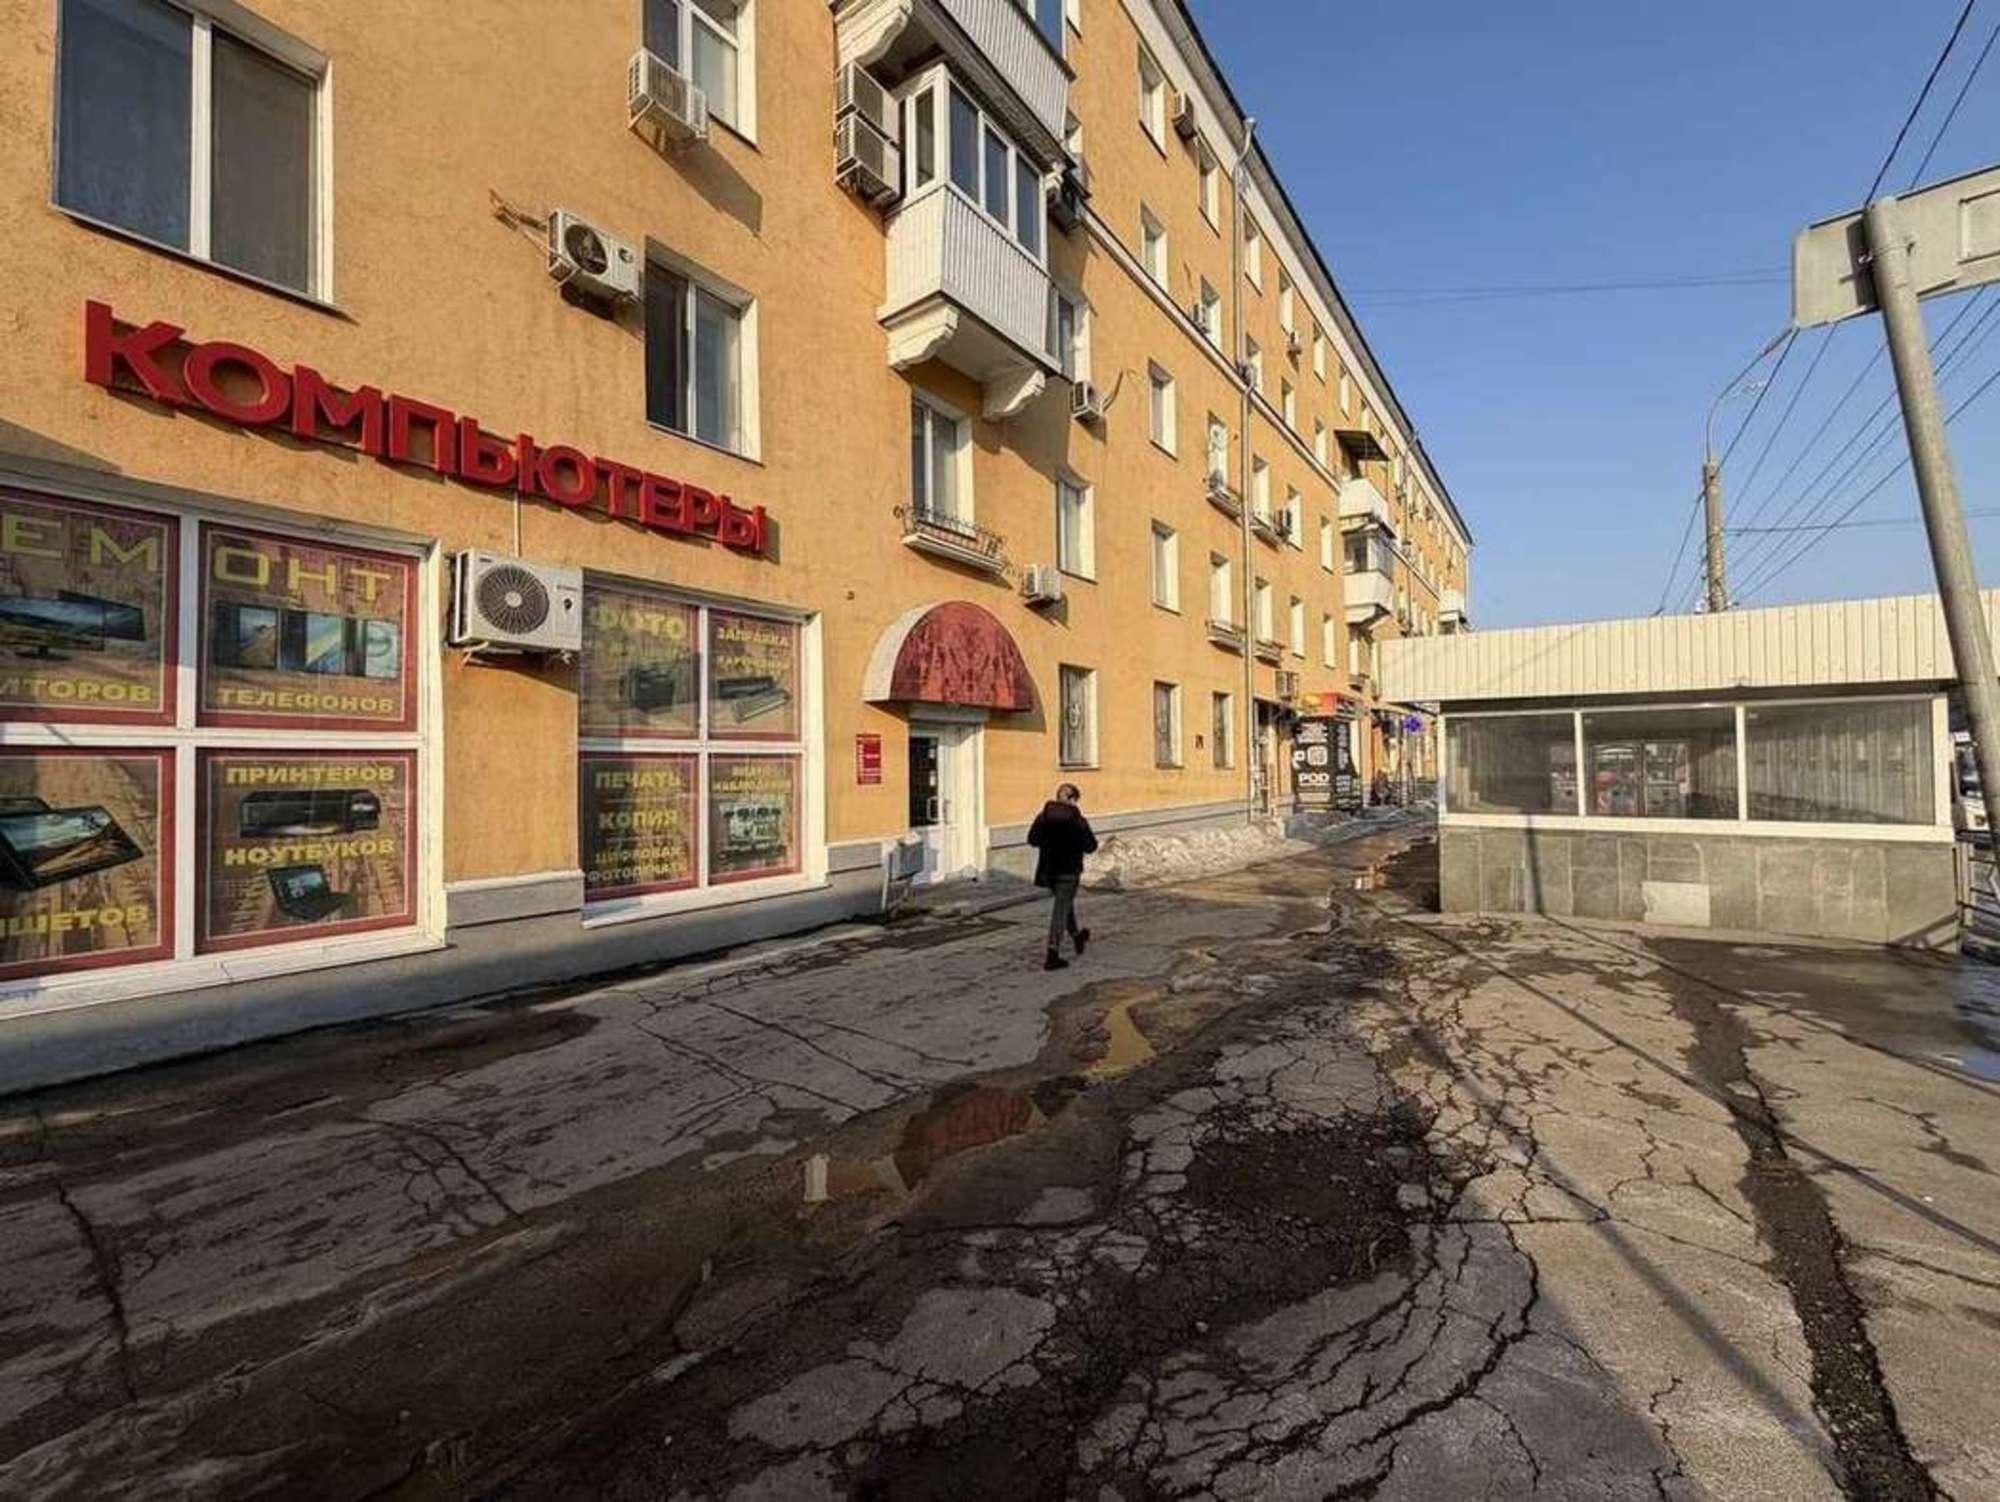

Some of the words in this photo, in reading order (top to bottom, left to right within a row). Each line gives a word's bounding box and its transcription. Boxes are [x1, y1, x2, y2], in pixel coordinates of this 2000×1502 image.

[84, 300, 767, 553] КОМПЬЮТЕРЫ
[218, 687, 394, 714] ТЕЛЕФОНОВ
[226, 763, 395, 784] ПРИНТЕРОВ
[595, 771, 681, 789] ПЕЧАТЬ
[598, 809, 678, 830] КОПИЯ
[224, 838, 395, 867] НОУТБУКОВ
